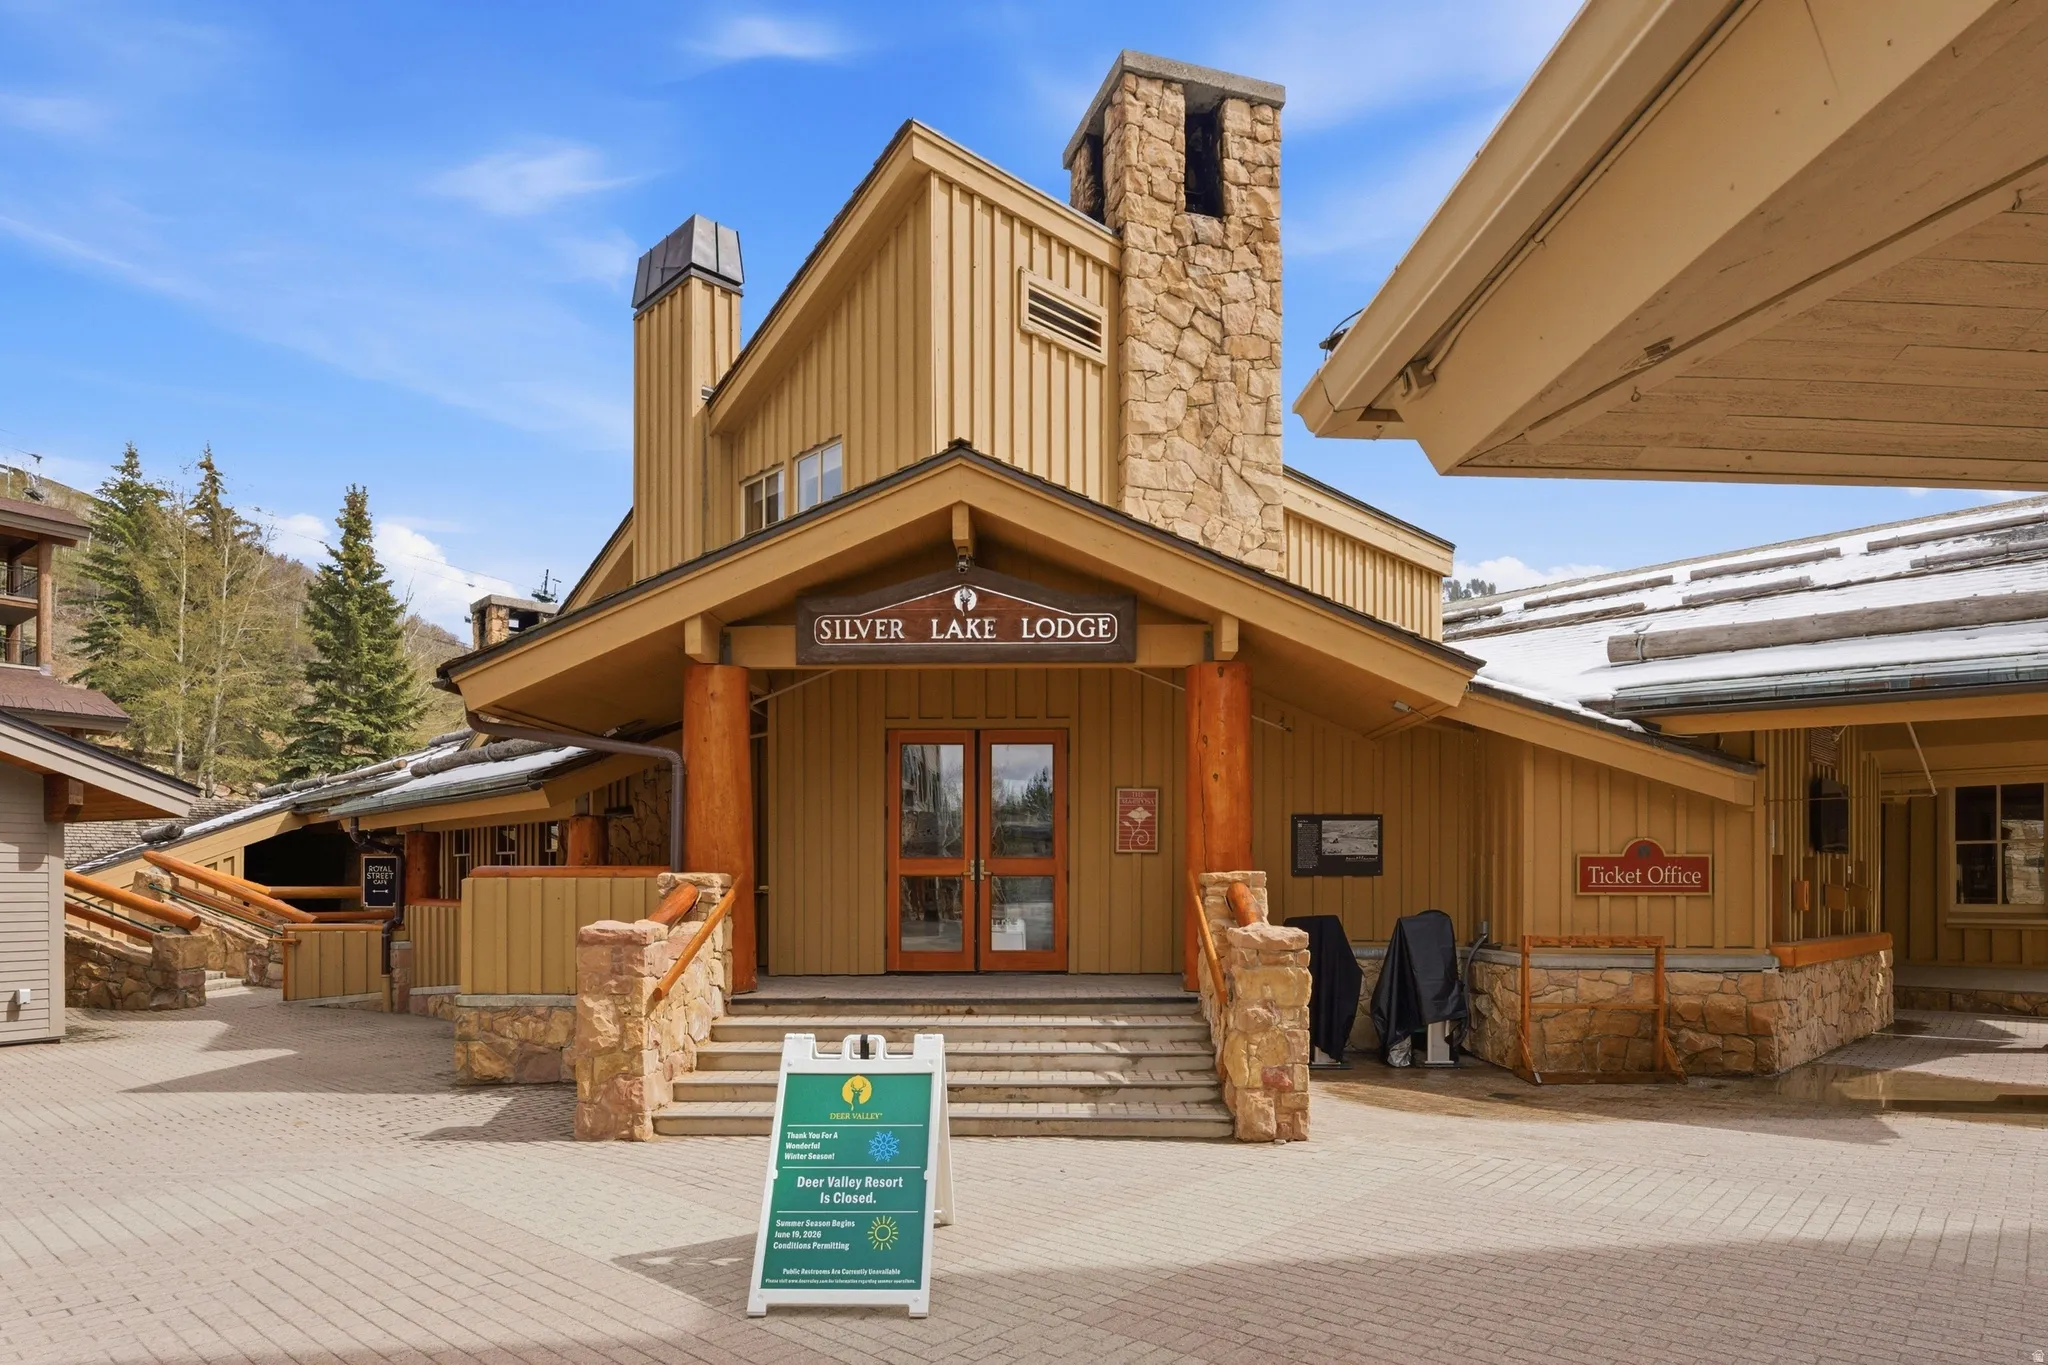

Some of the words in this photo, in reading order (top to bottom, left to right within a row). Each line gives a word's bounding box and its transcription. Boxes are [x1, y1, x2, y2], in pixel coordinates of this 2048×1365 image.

[819, 618, 905, 640] SILVER
[931, 617, 997, 640] LAKE
[1021, 617, 1112, 639] LODGE
[1587, 866, 1642, 884] Ticket
[1647, 865, 1702, 884] Office
[829, 1112, 851, 1120] DEER
[784, 1152, 807, 1160] Winter
[808, 1152, 835, 1160] Season!
[796, 1176, 825, 1188] Deer
[827, 1176, 862, 1190] Valley
[864, 1176, 904, 1188] Resort
[820, 1192, 831, 1204] Is
[833, 1192, 877, 1204] Closed.
[776, 1219, 805, 1227] Summer
[805, 1219, 831, 1227] Season
[832, 1219, 856, 1228] Begins
[774, 1230, 791, 1238] June
[792, 1230, 801, 1239] 19,
[803, 1230, 822, 1238] 2026
[773, 1242, 811, 1250] Conditions
[812, 1242, 850, 1251] Permitting
[841, 1268, 868, 1276] Currently
